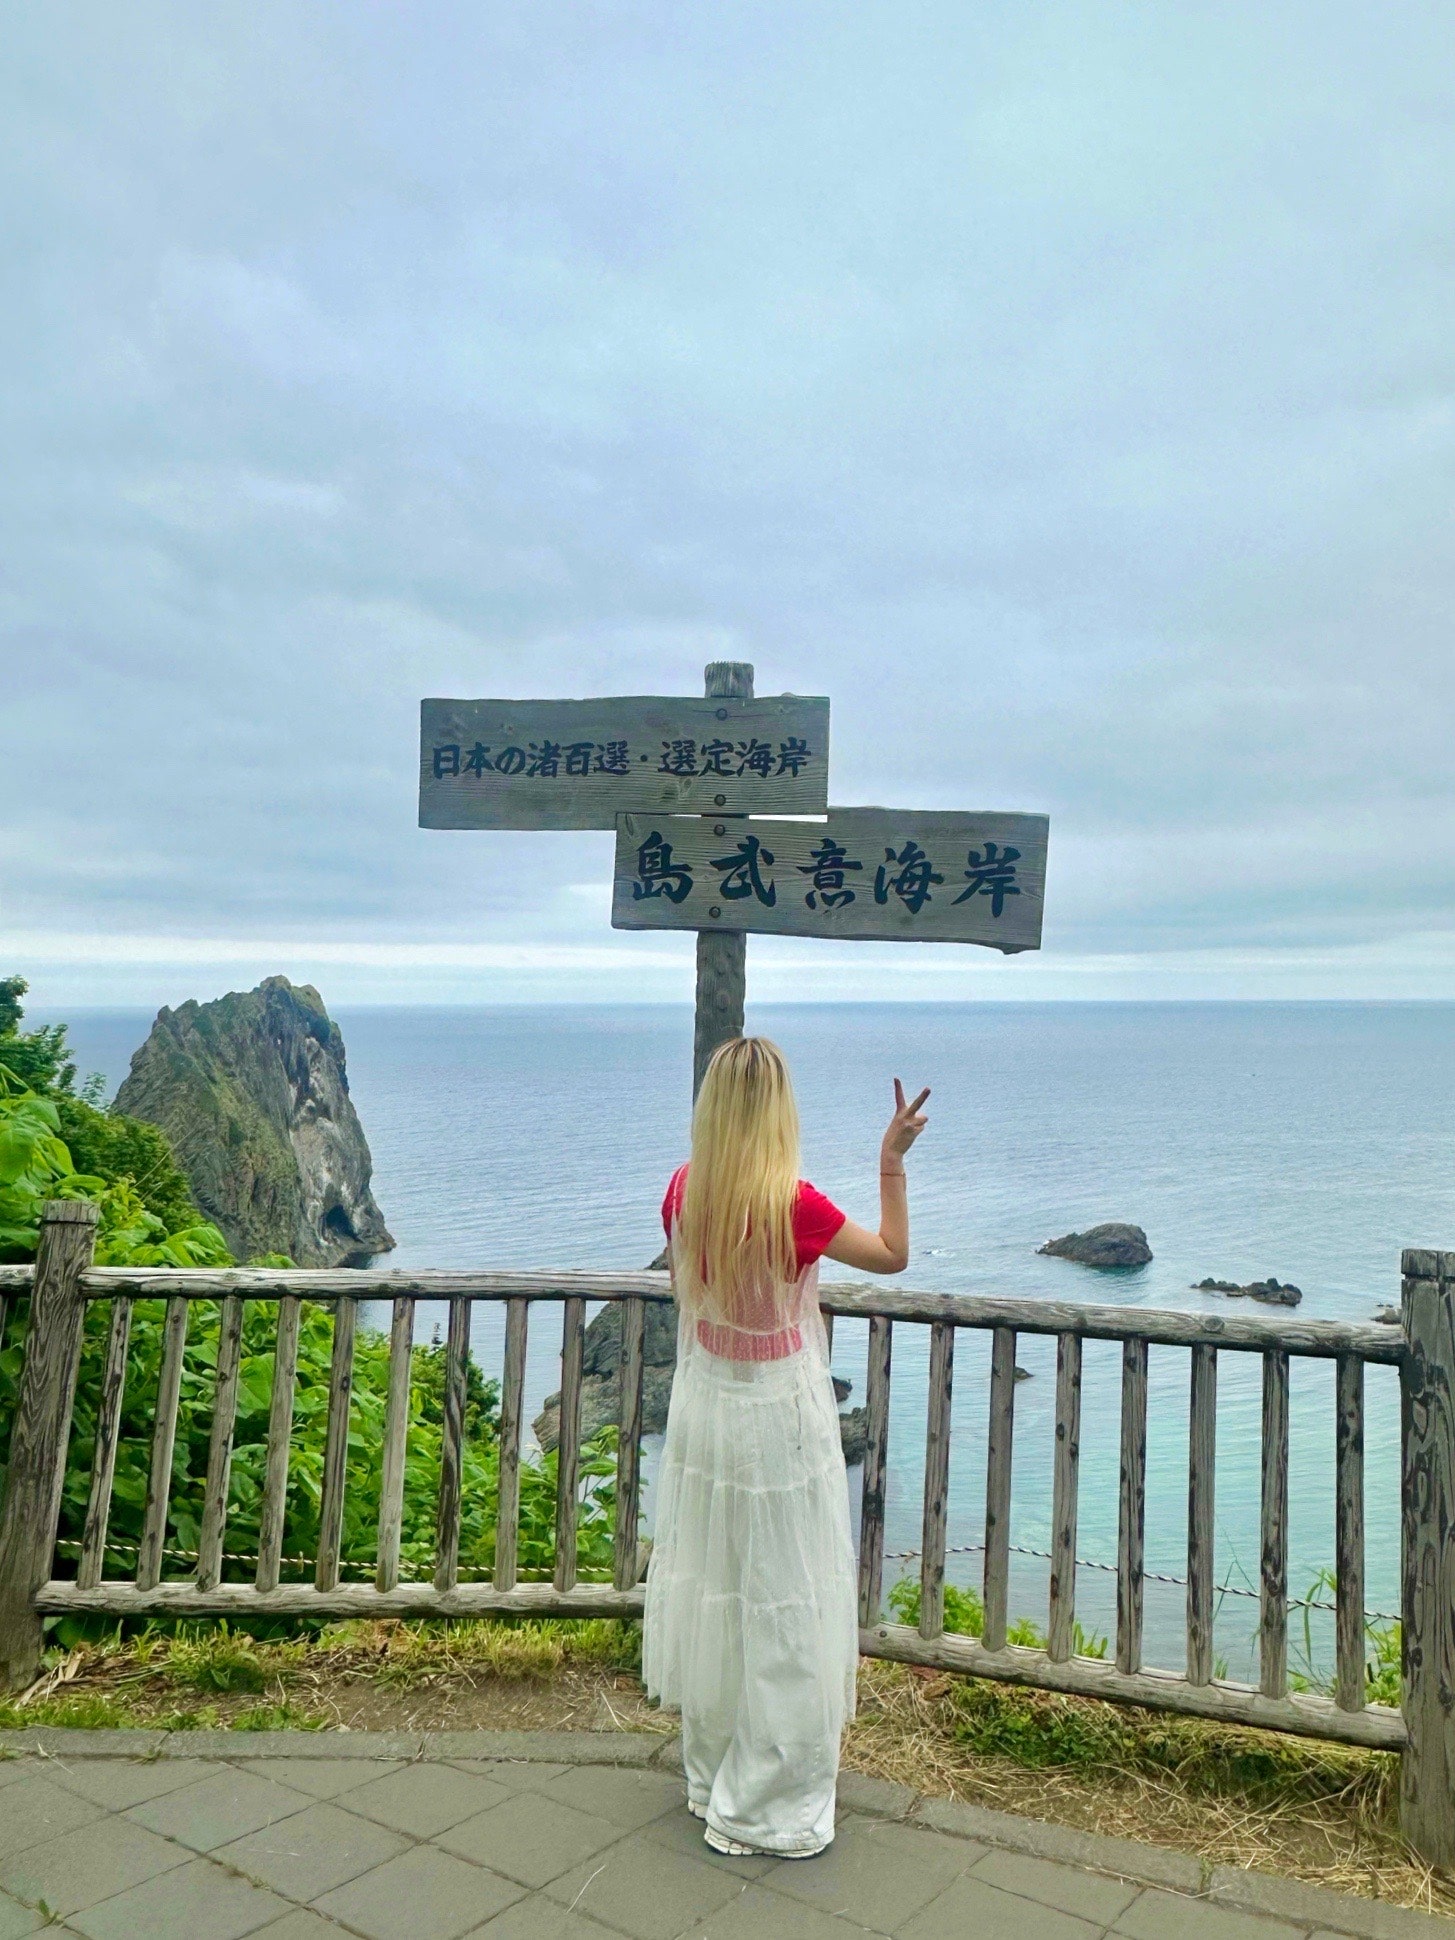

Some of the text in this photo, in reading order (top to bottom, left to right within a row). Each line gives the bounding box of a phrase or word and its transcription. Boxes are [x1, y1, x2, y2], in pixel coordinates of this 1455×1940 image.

[432, 737, 812, 779] 日本の渚百選・選定海岸
[633, 831, 1022, 918] 島武意海岸
